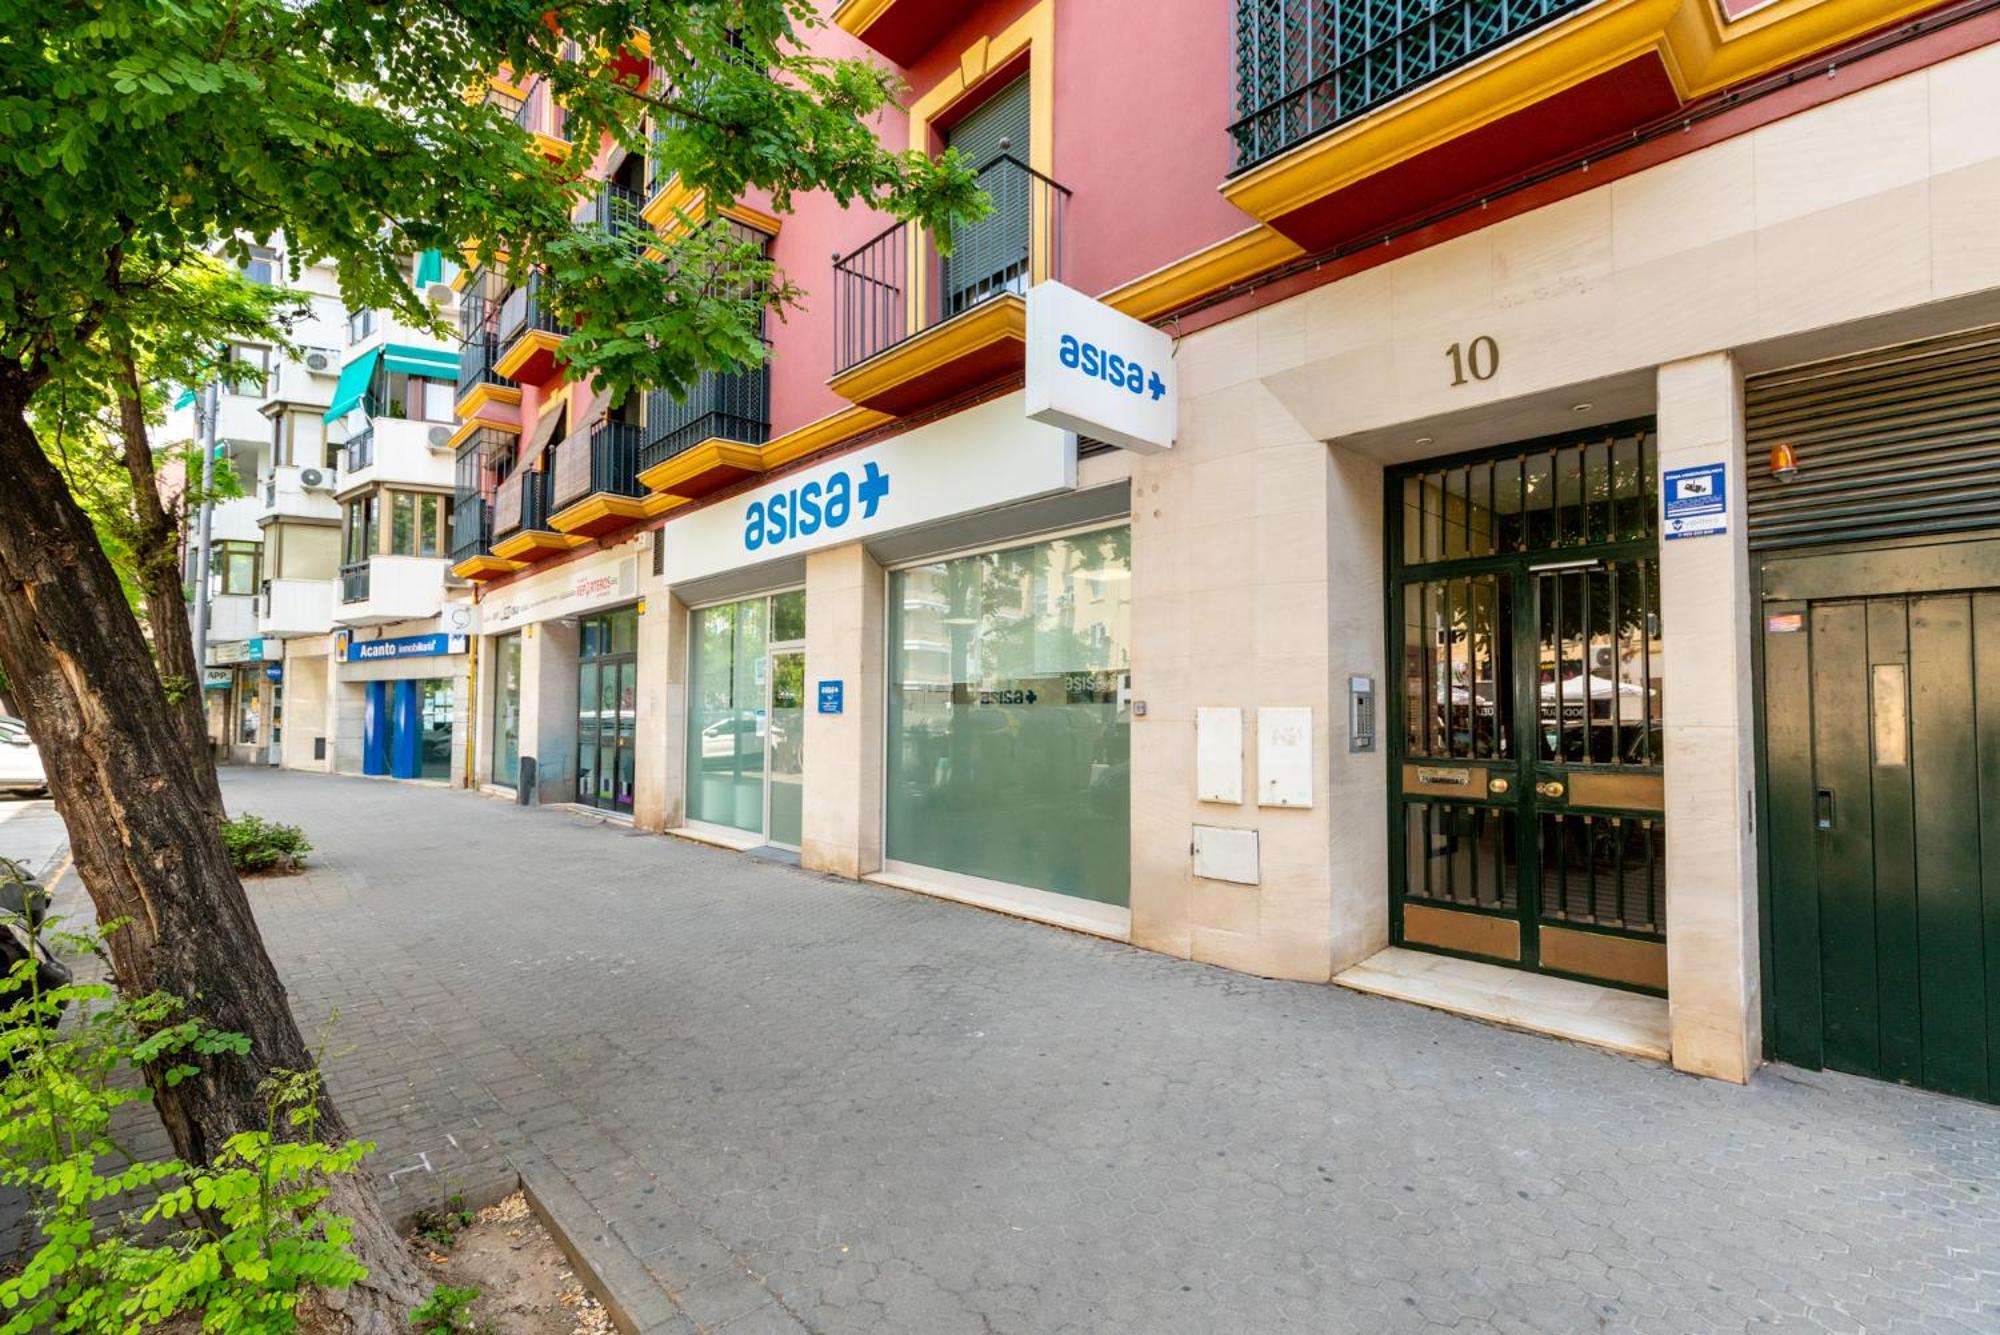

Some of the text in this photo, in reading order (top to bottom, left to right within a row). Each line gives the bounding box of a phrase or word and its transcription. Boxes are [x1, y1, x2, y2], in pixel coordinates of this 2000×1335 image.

[1059, 334, 1144, 395] asisa
[1445, 335, 1499, 387] 10
[745, 471, 850, 551] asisa
[360, 642, 396, 658] Acanto
[979, 689, 1024, 705] asisa
